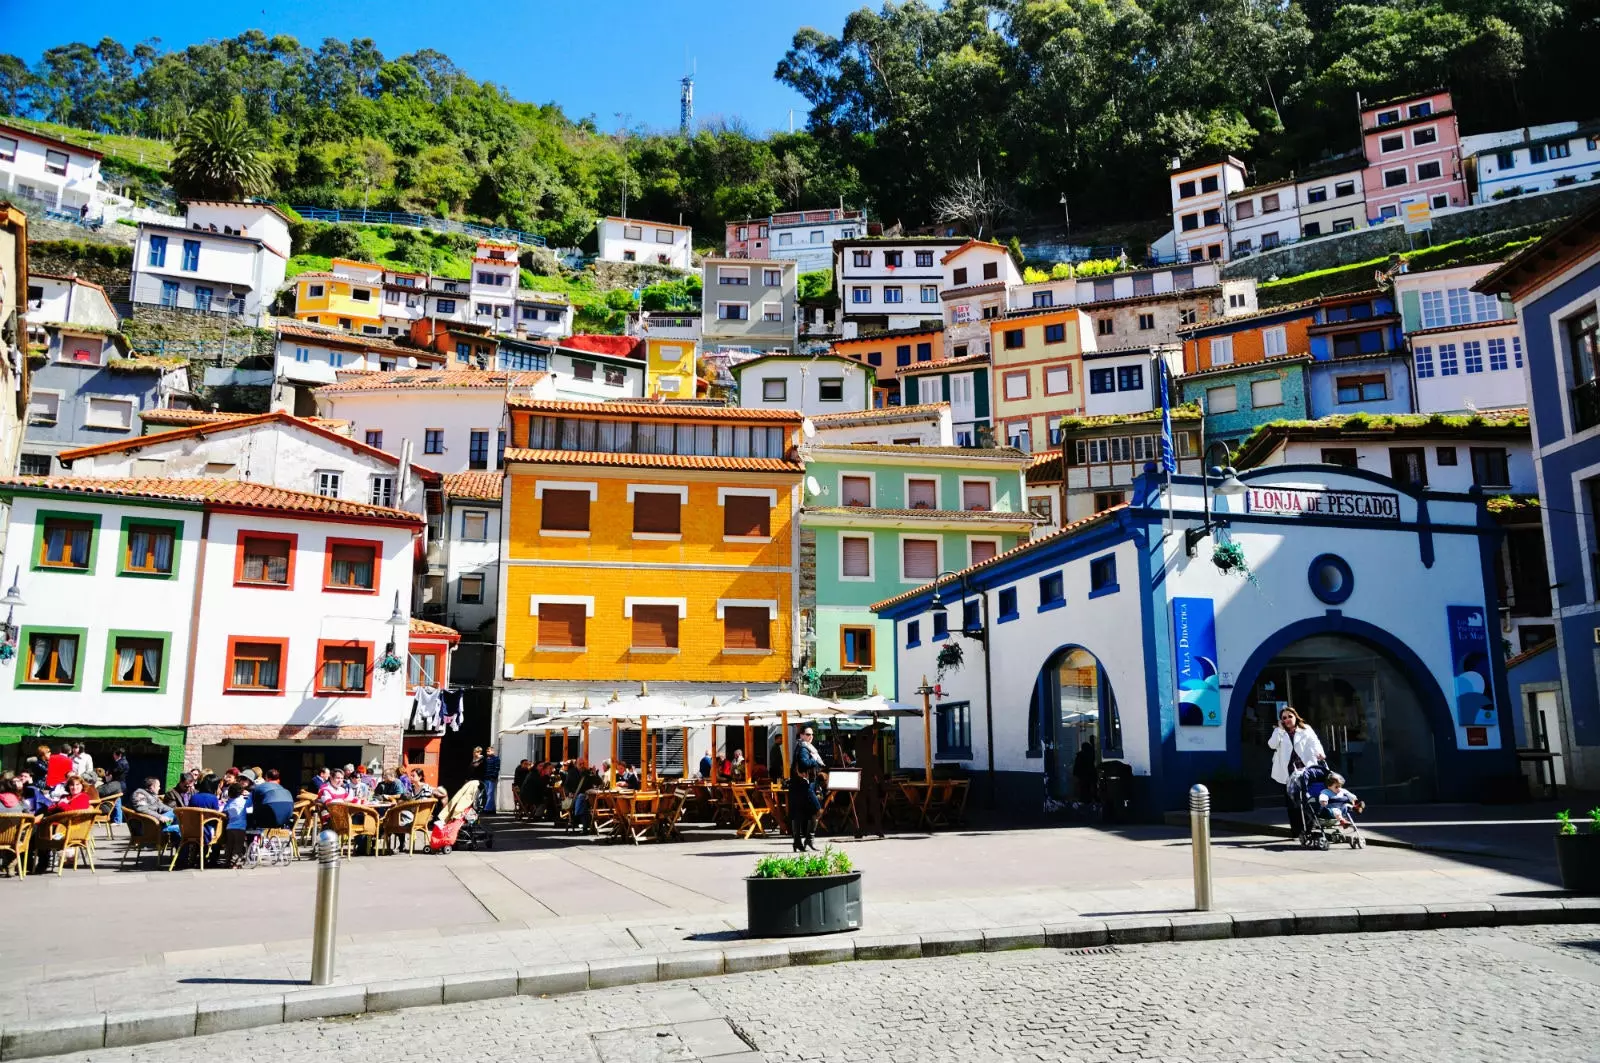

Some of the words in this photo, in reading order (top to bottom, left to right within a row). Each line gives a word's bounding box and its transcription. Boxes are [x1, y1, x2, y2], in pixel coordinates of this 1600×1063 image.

[1253, 490, 1301, 511] LONJA
[1307, 496, 1324, 512] DE
[1327, 494, 1393, 516] PESCADO
[1181, 652, 1190, 676] AULA
